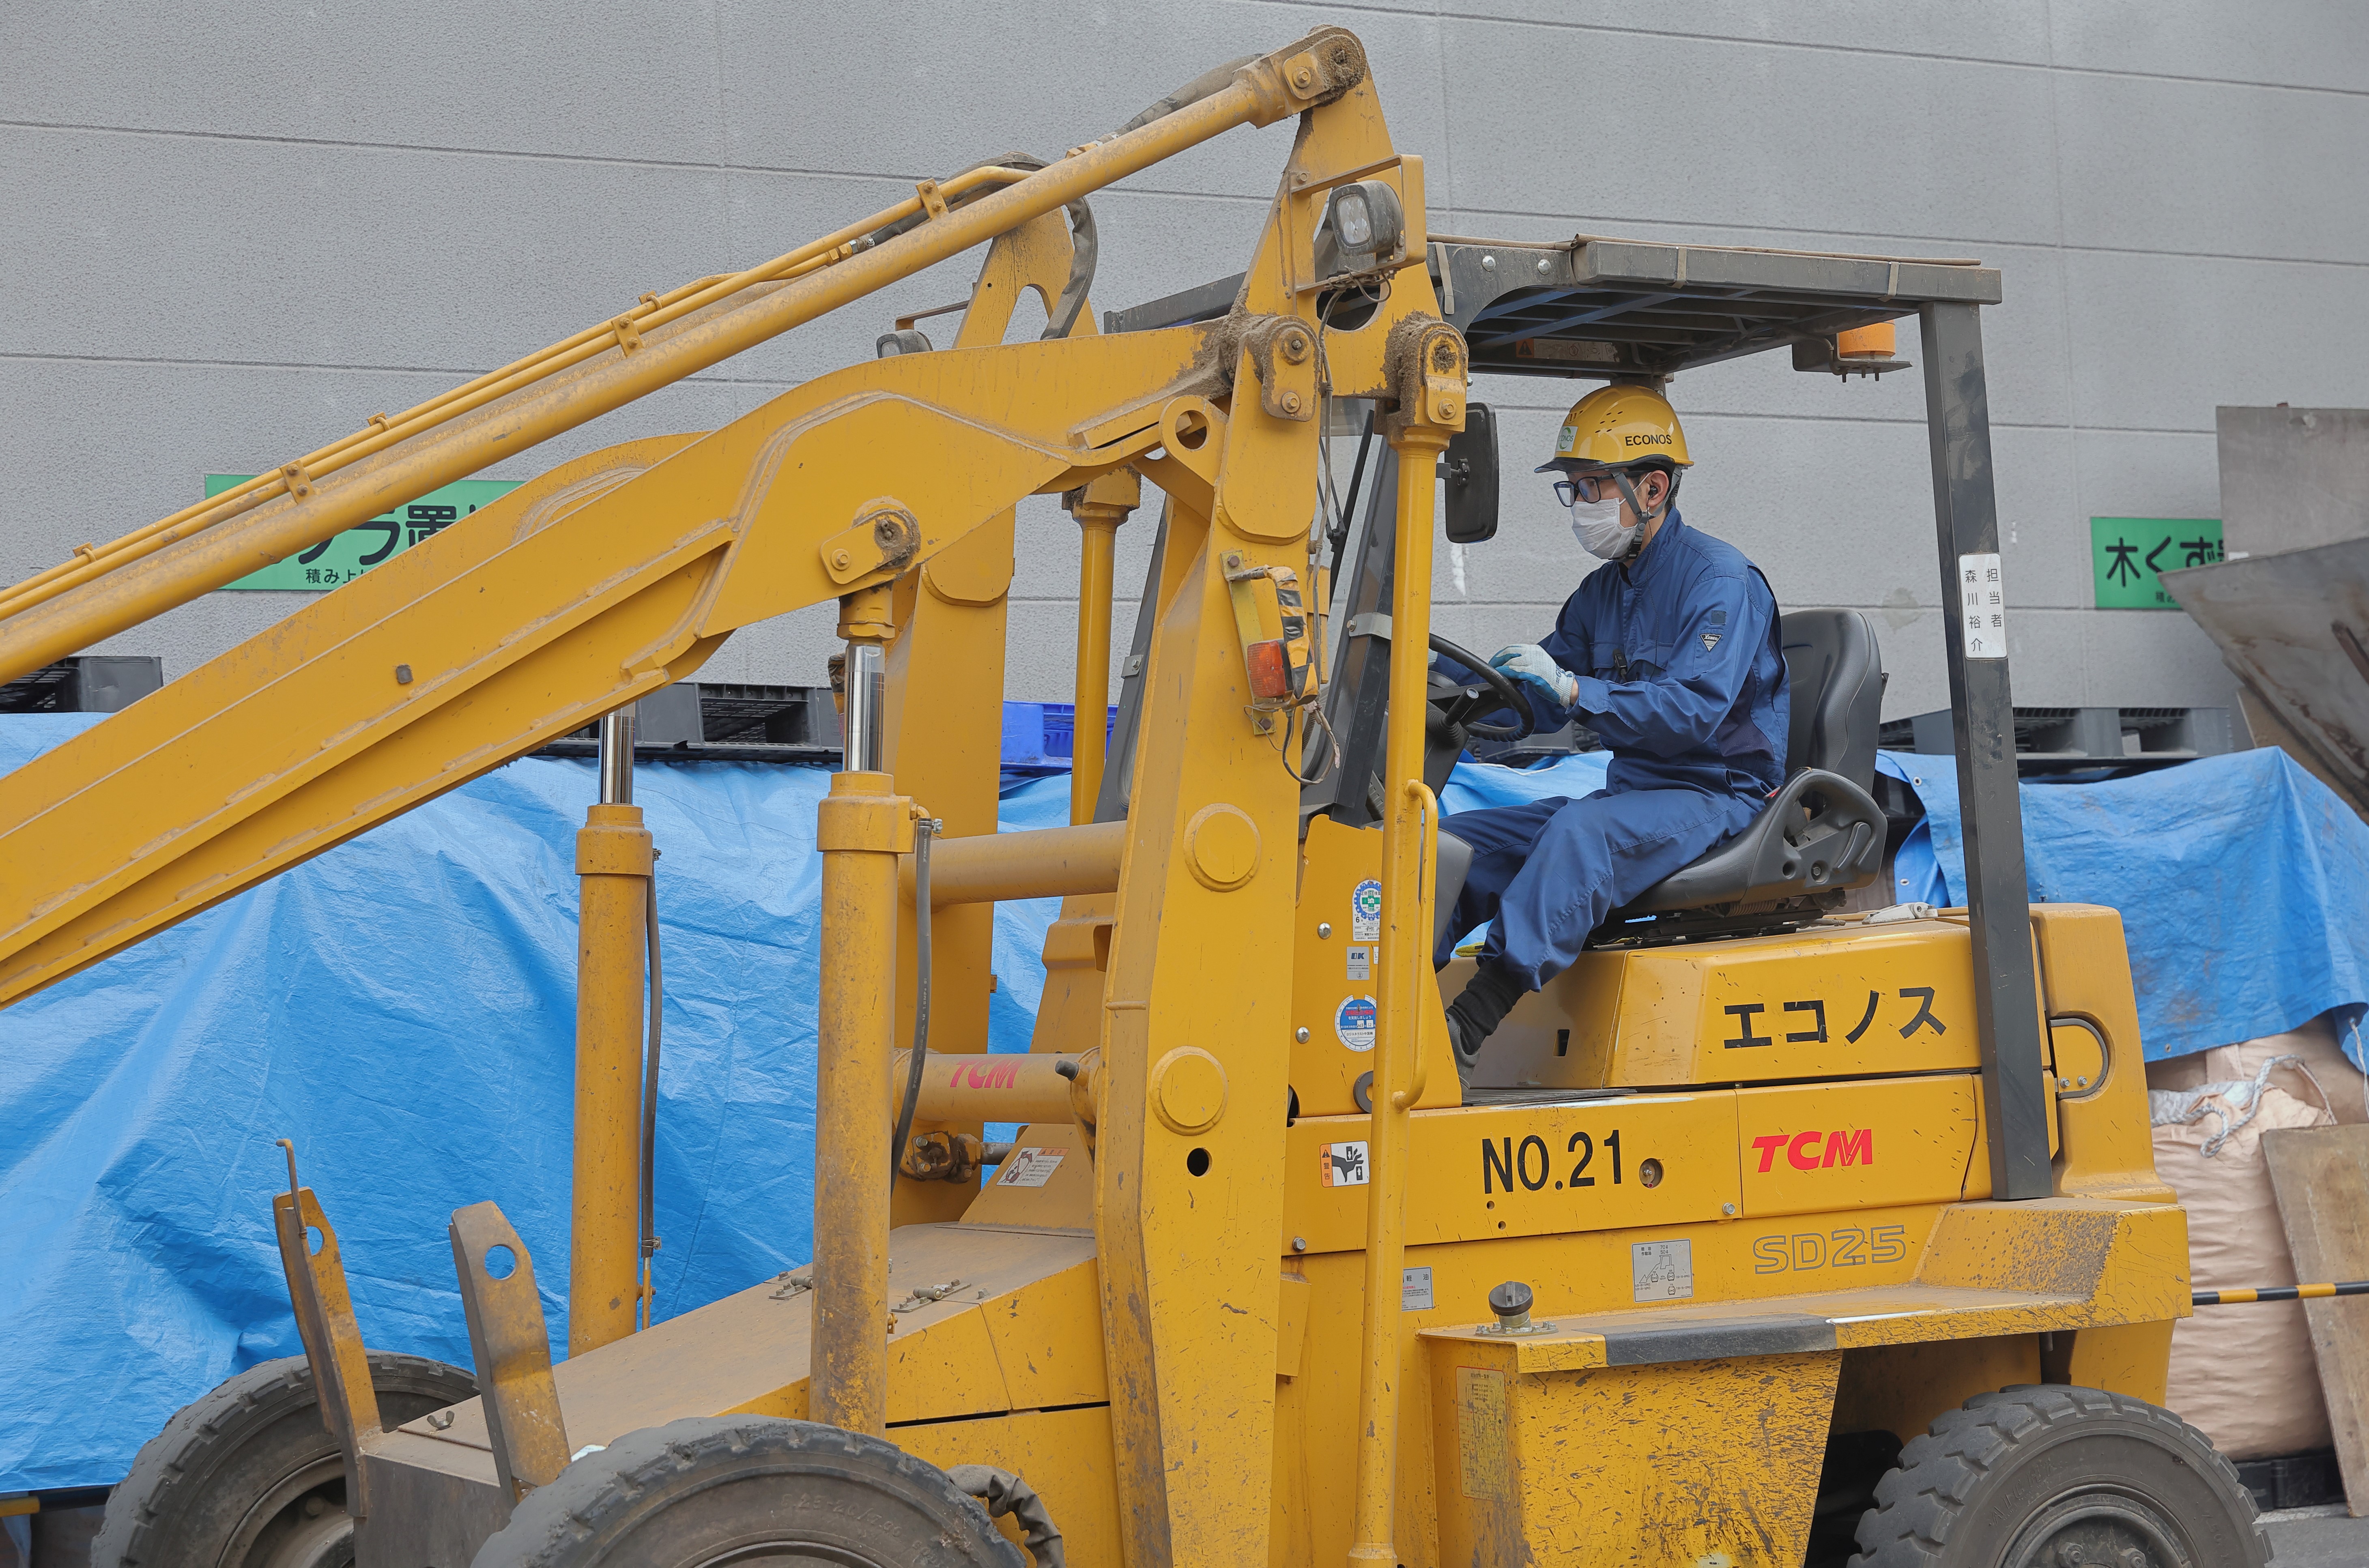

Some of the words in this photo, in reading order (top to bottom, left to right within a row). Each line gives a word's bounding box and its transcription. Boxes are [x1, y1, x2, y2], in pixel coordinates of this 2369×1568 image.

[1625, 434, 1672, 446] ECONOS
[306, 568, 365, 584] 積み上
[2105, 536, 2224, 587] 木くず
[1965, 570, 1983, 651] 森川裕介
[1986, 569, 2002, 627] 担当者
[1724, 986, 1947, 1049] エコノス
[950, 1058, 1027, 1089] TCM
[1323, 1162, 1330, 1180] 警告
[1482, 1130, 1621, 1194] NO.21
[1752, 1129, 1873, 1173] TCM
[1753, 1224, 1906, 1274] SD25
